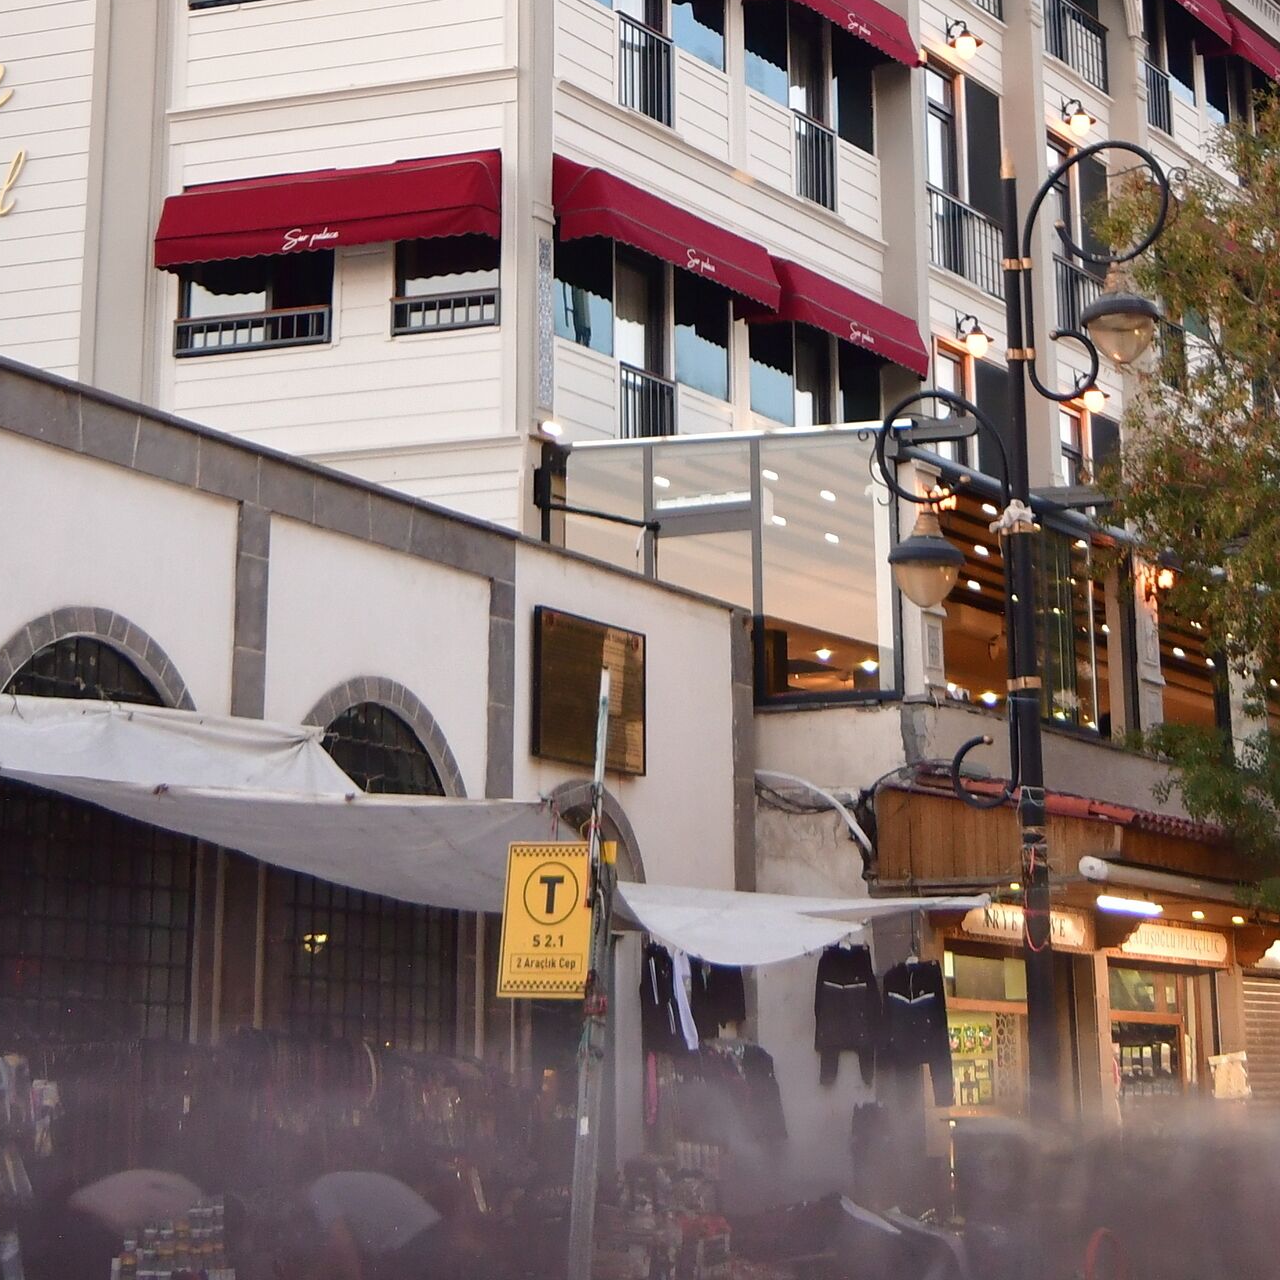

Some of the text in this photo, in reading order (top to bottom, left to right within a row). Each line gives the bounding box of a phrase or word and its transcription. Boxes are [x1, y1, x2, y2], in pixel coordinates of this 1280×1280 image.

[282, 228, 310, 251] Sur
[540, 875, 564, 914] T
[544, 934, 564, 948] 2.1
[517, 957, 522, 968] 2
[559, 958, 577, 970] Cep
